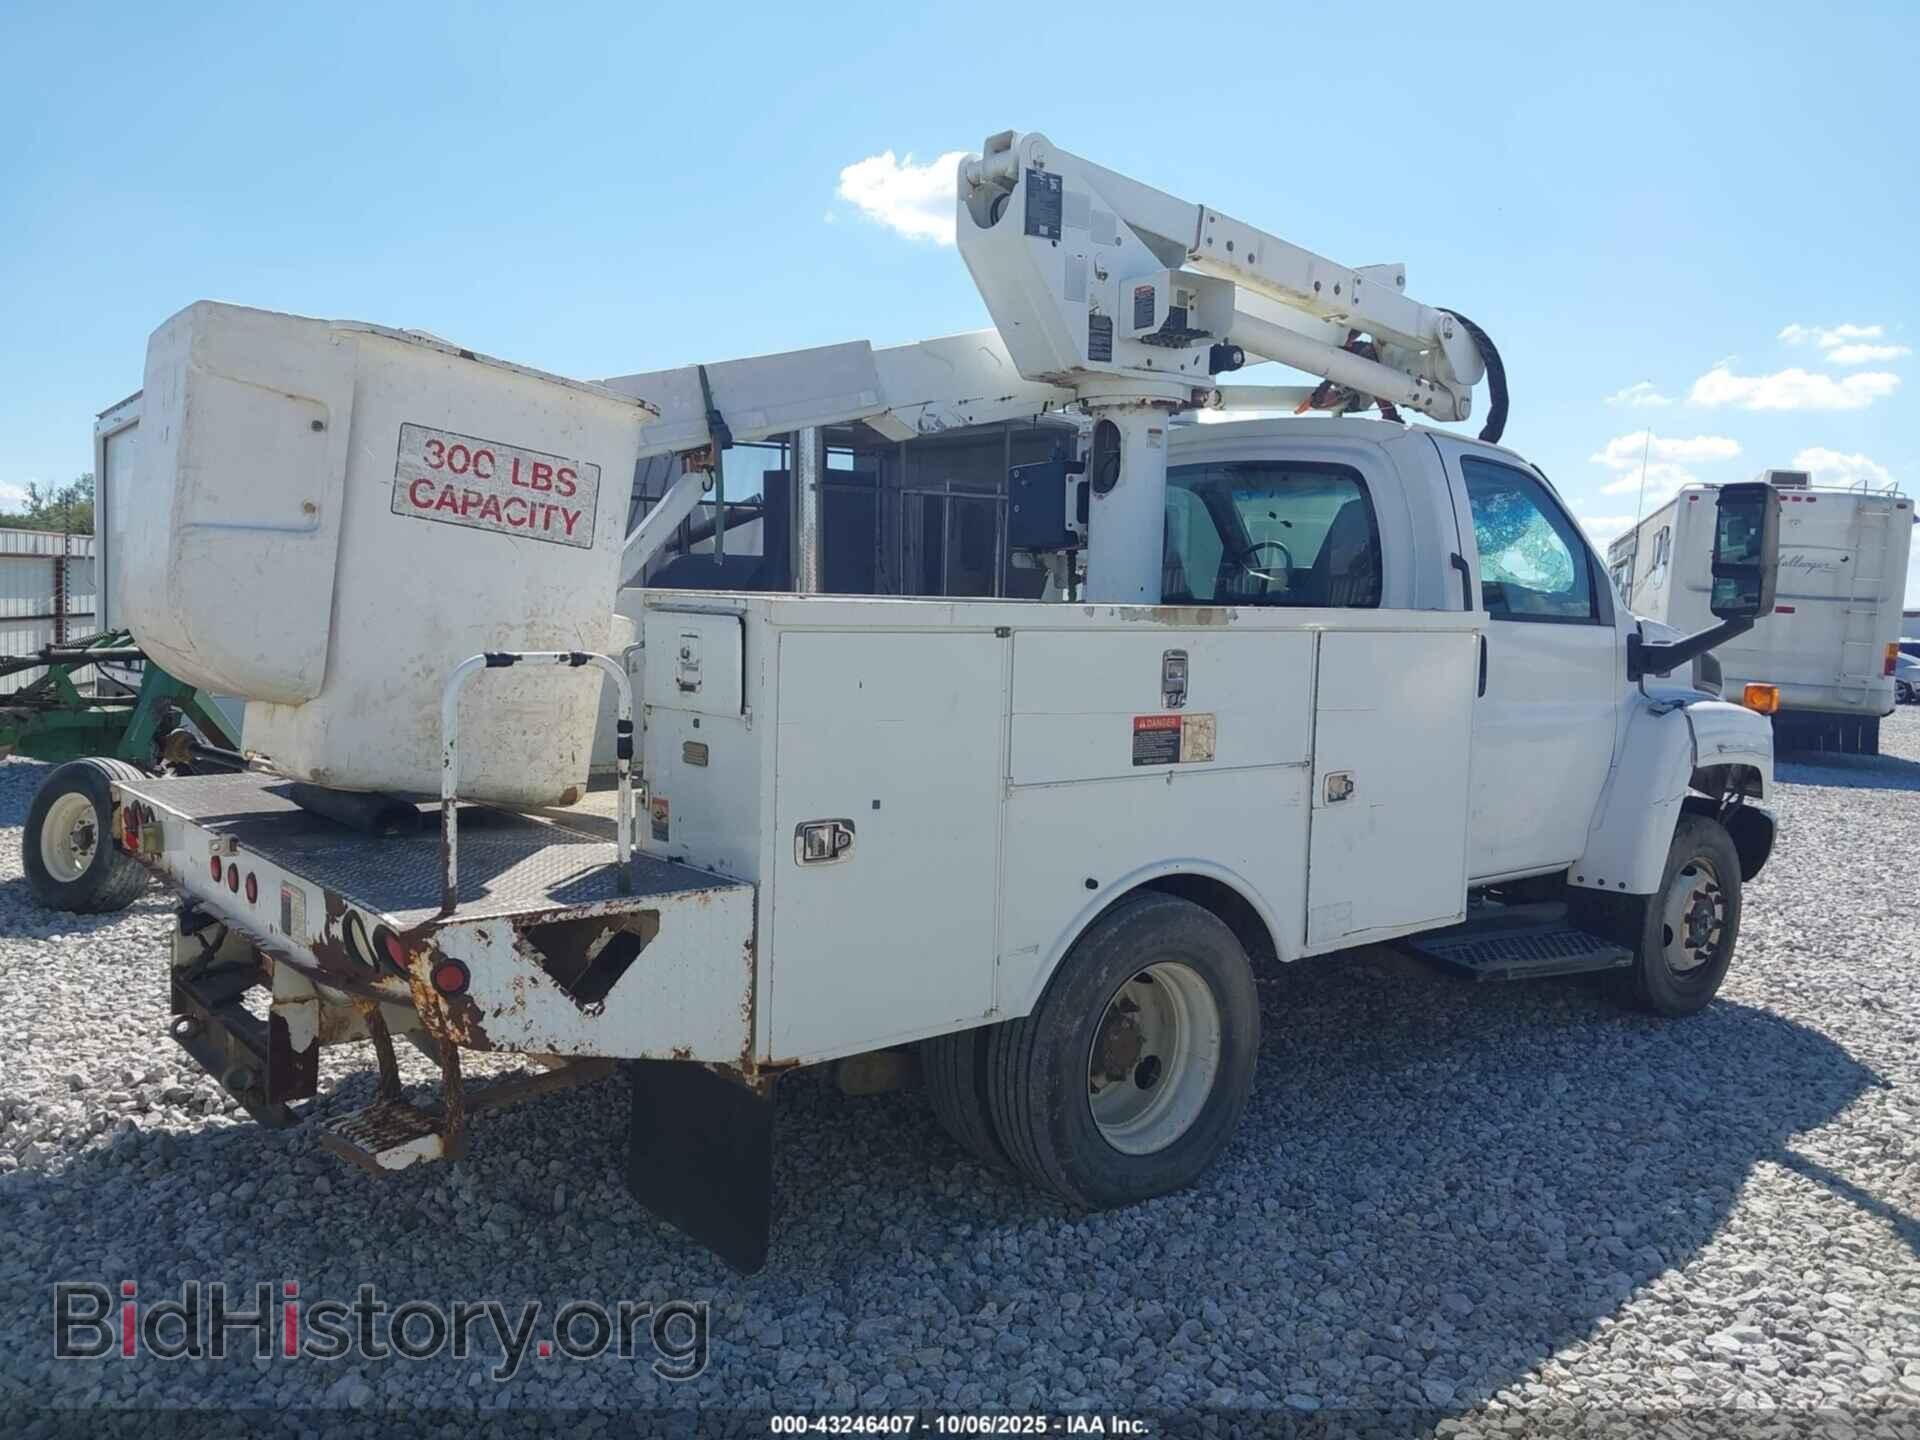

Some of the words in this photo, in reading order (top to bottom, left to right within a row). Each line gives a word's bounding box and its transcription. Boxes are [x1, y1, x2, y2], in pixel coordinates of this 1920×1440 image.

[423, 439, 495, 478] 300
[511, 458, 577, 497] LBS
[409, 479, 581, 535] CAPACITY
[1146, 718, 1176, 729] DANGER
